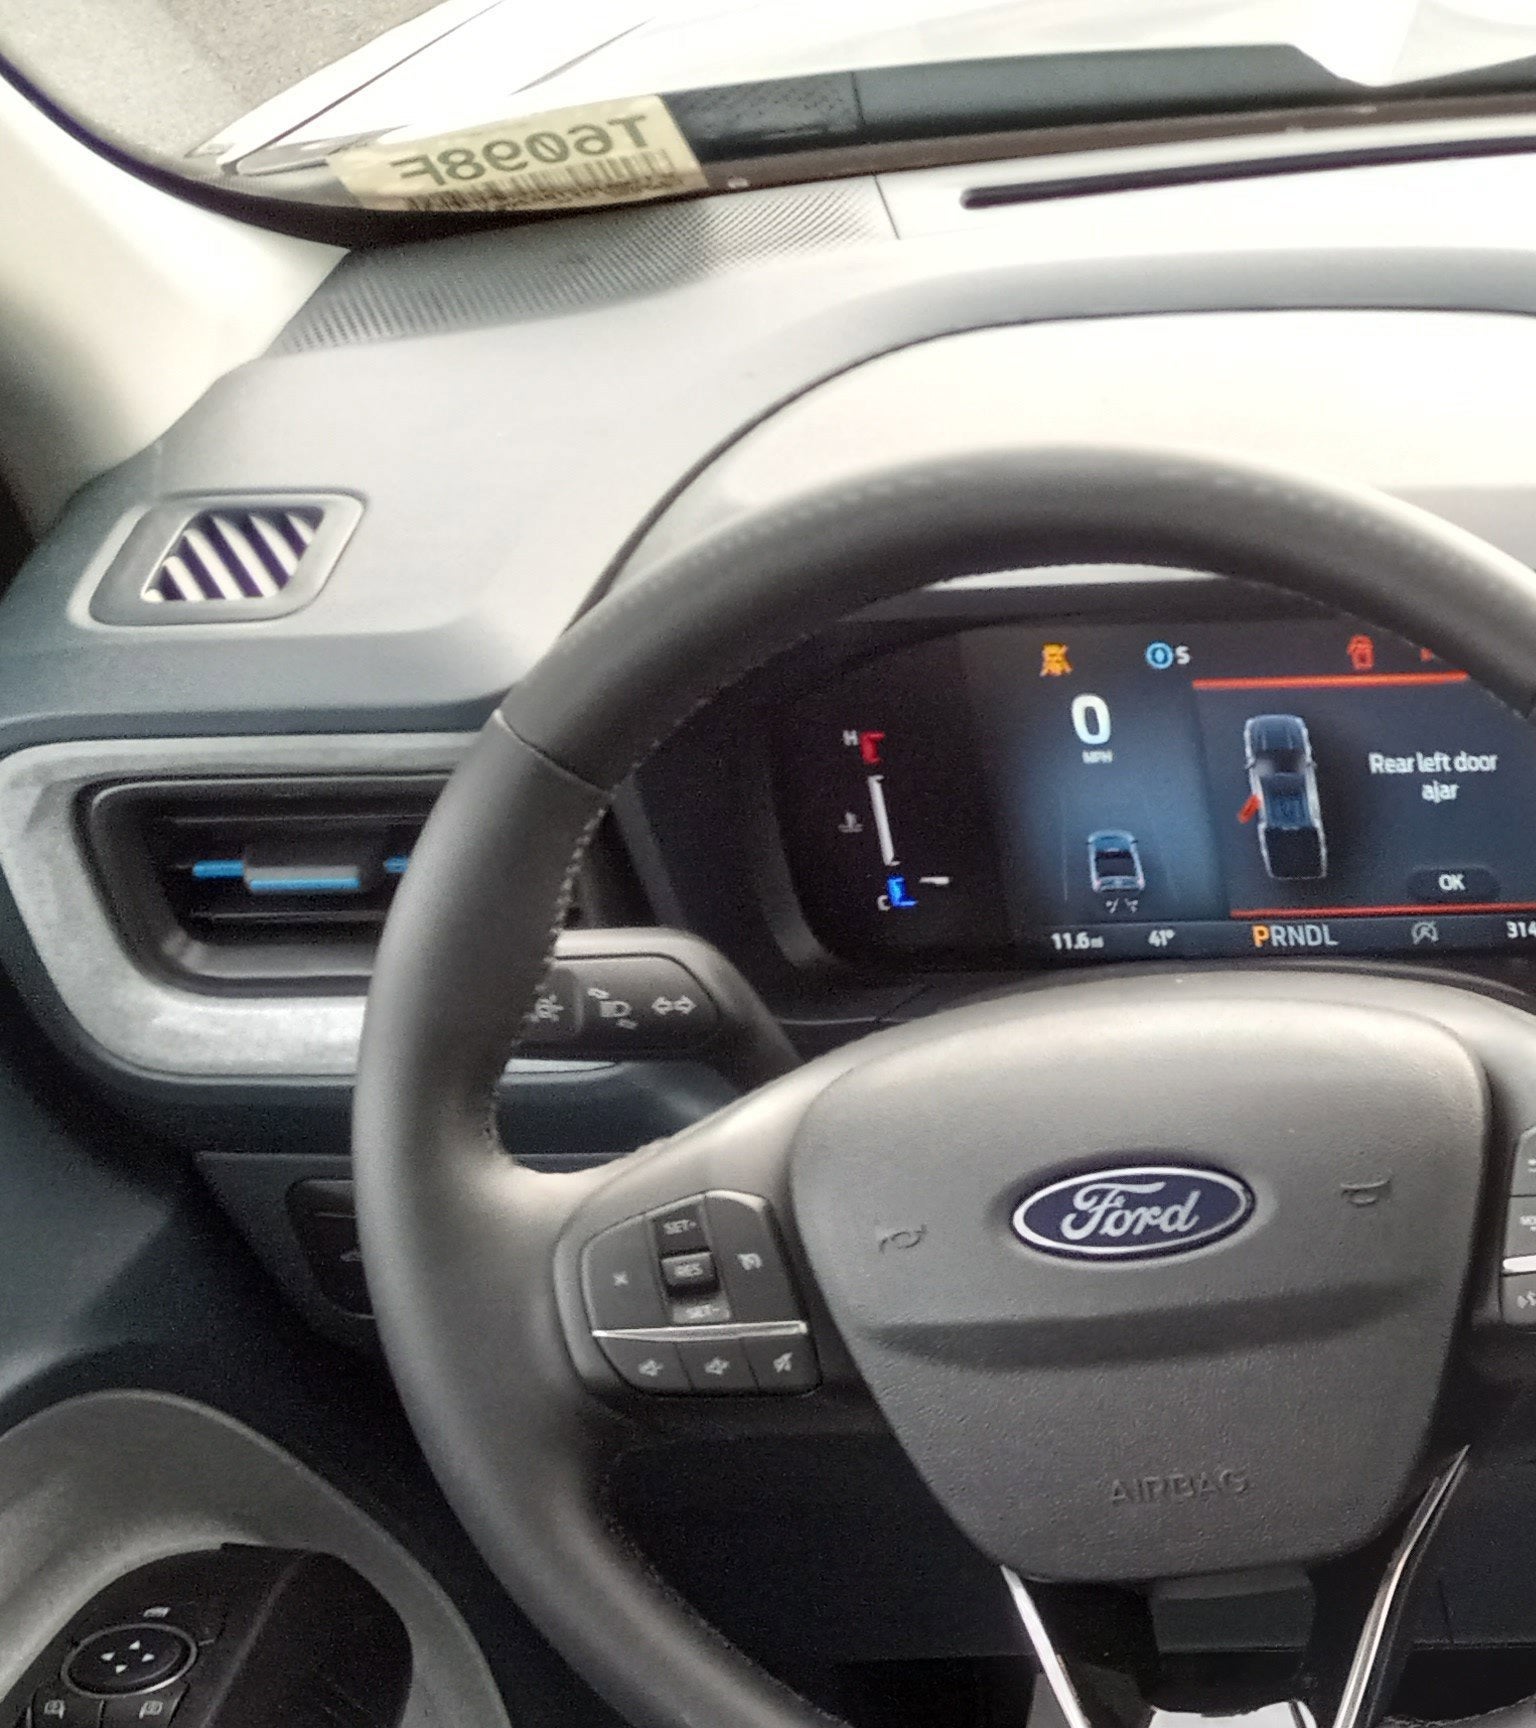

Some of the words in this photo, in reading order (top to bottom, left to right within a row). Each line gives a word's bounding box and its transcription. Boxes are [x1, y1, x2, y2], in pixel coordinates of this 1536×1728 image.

[1071, 693, 1111, 744] 0
[843, 730, 858, 745] H
[1082, 750, 1113, 763] MPH
[1369, 752, 1415, 774] Rear
[1416, 752, 1451, 772] left
[1453, 751, 1498, 772] door
[1422, 780, 1459, 804] ajar
[1438, 873, 1466, 891] OK
[1252, 924, 1339, 948] PRNDL
[1061, 1181, 1201, 1240] Ford
[1112, 1469, 1249, 1502] AIRBAG
